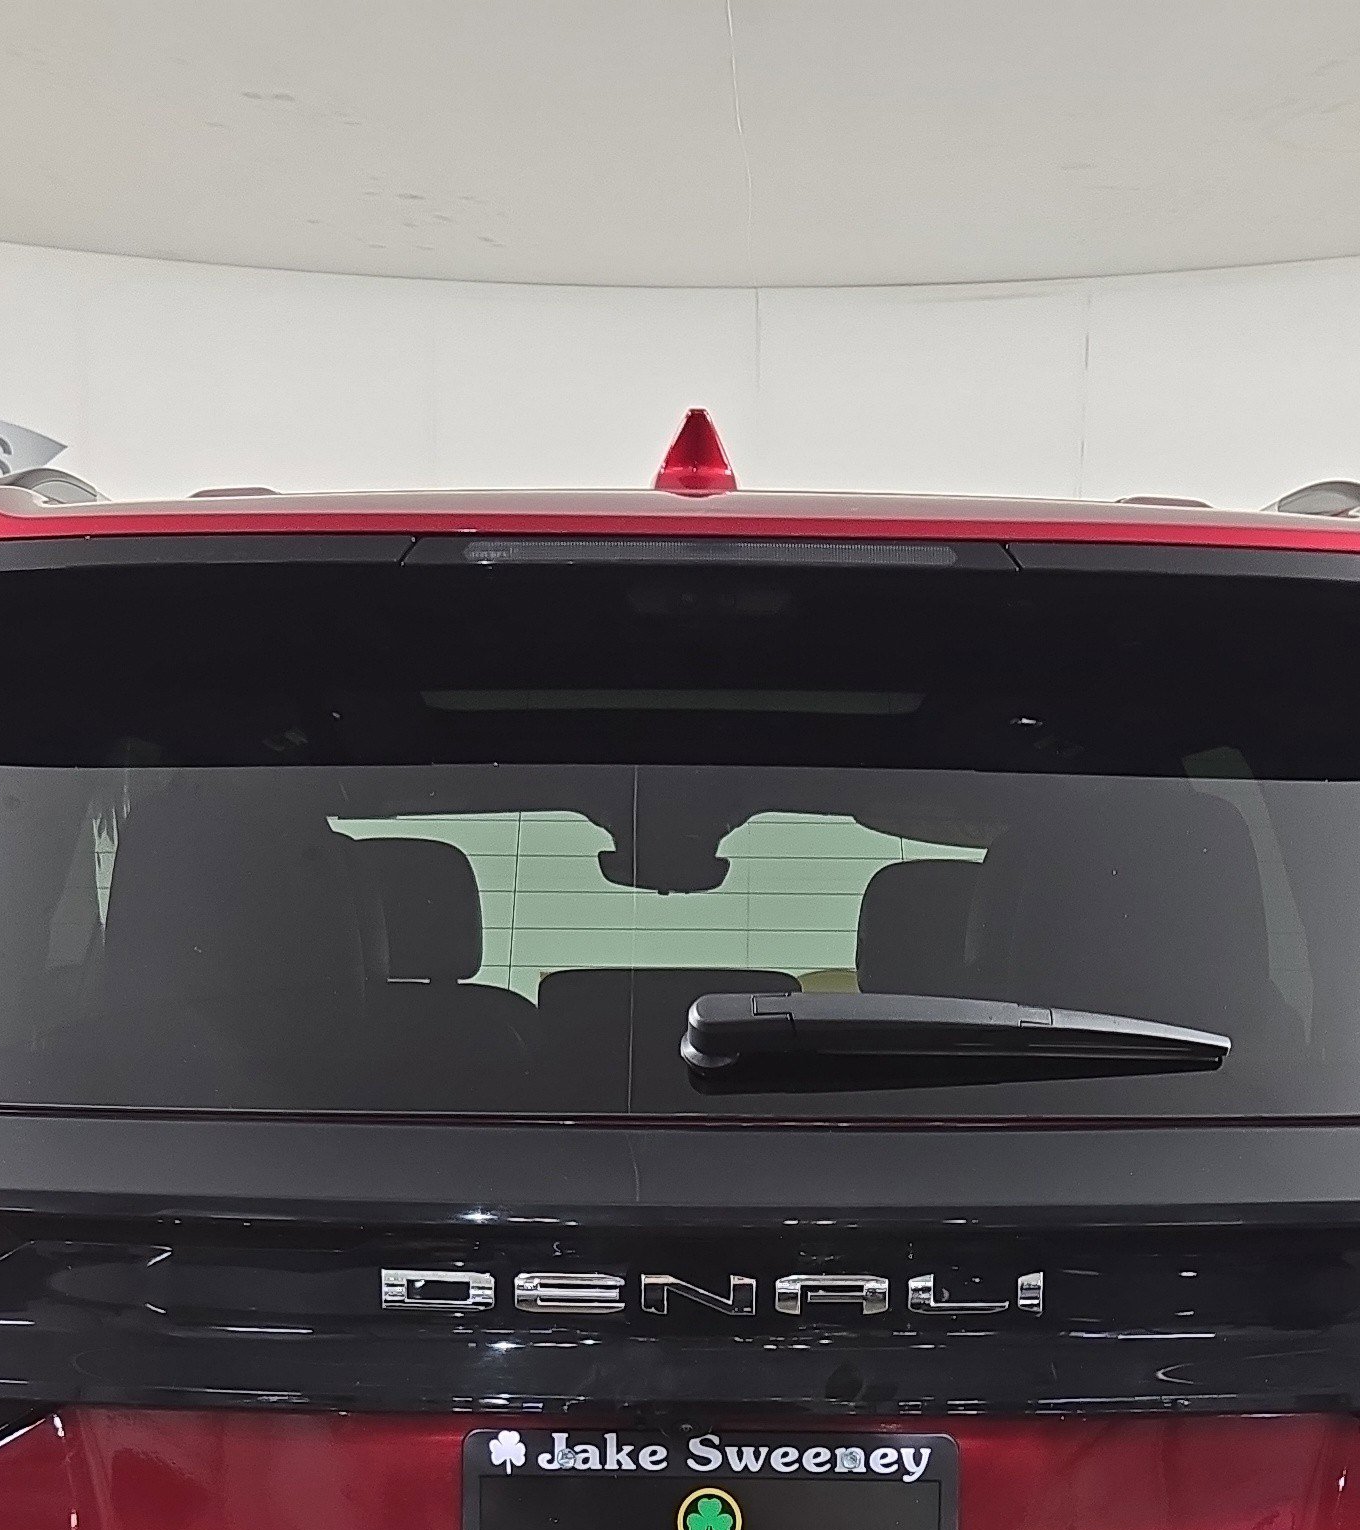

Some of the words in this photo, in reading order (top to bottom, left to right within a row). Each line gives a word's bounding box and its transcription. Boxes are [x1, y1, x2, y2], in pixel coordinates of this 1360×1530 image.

[380, 1268, 1045, 1317] DENALI
[538, 1432, 667, 1472] Jake
[686, 1436, 932, 1482] Sweeney
